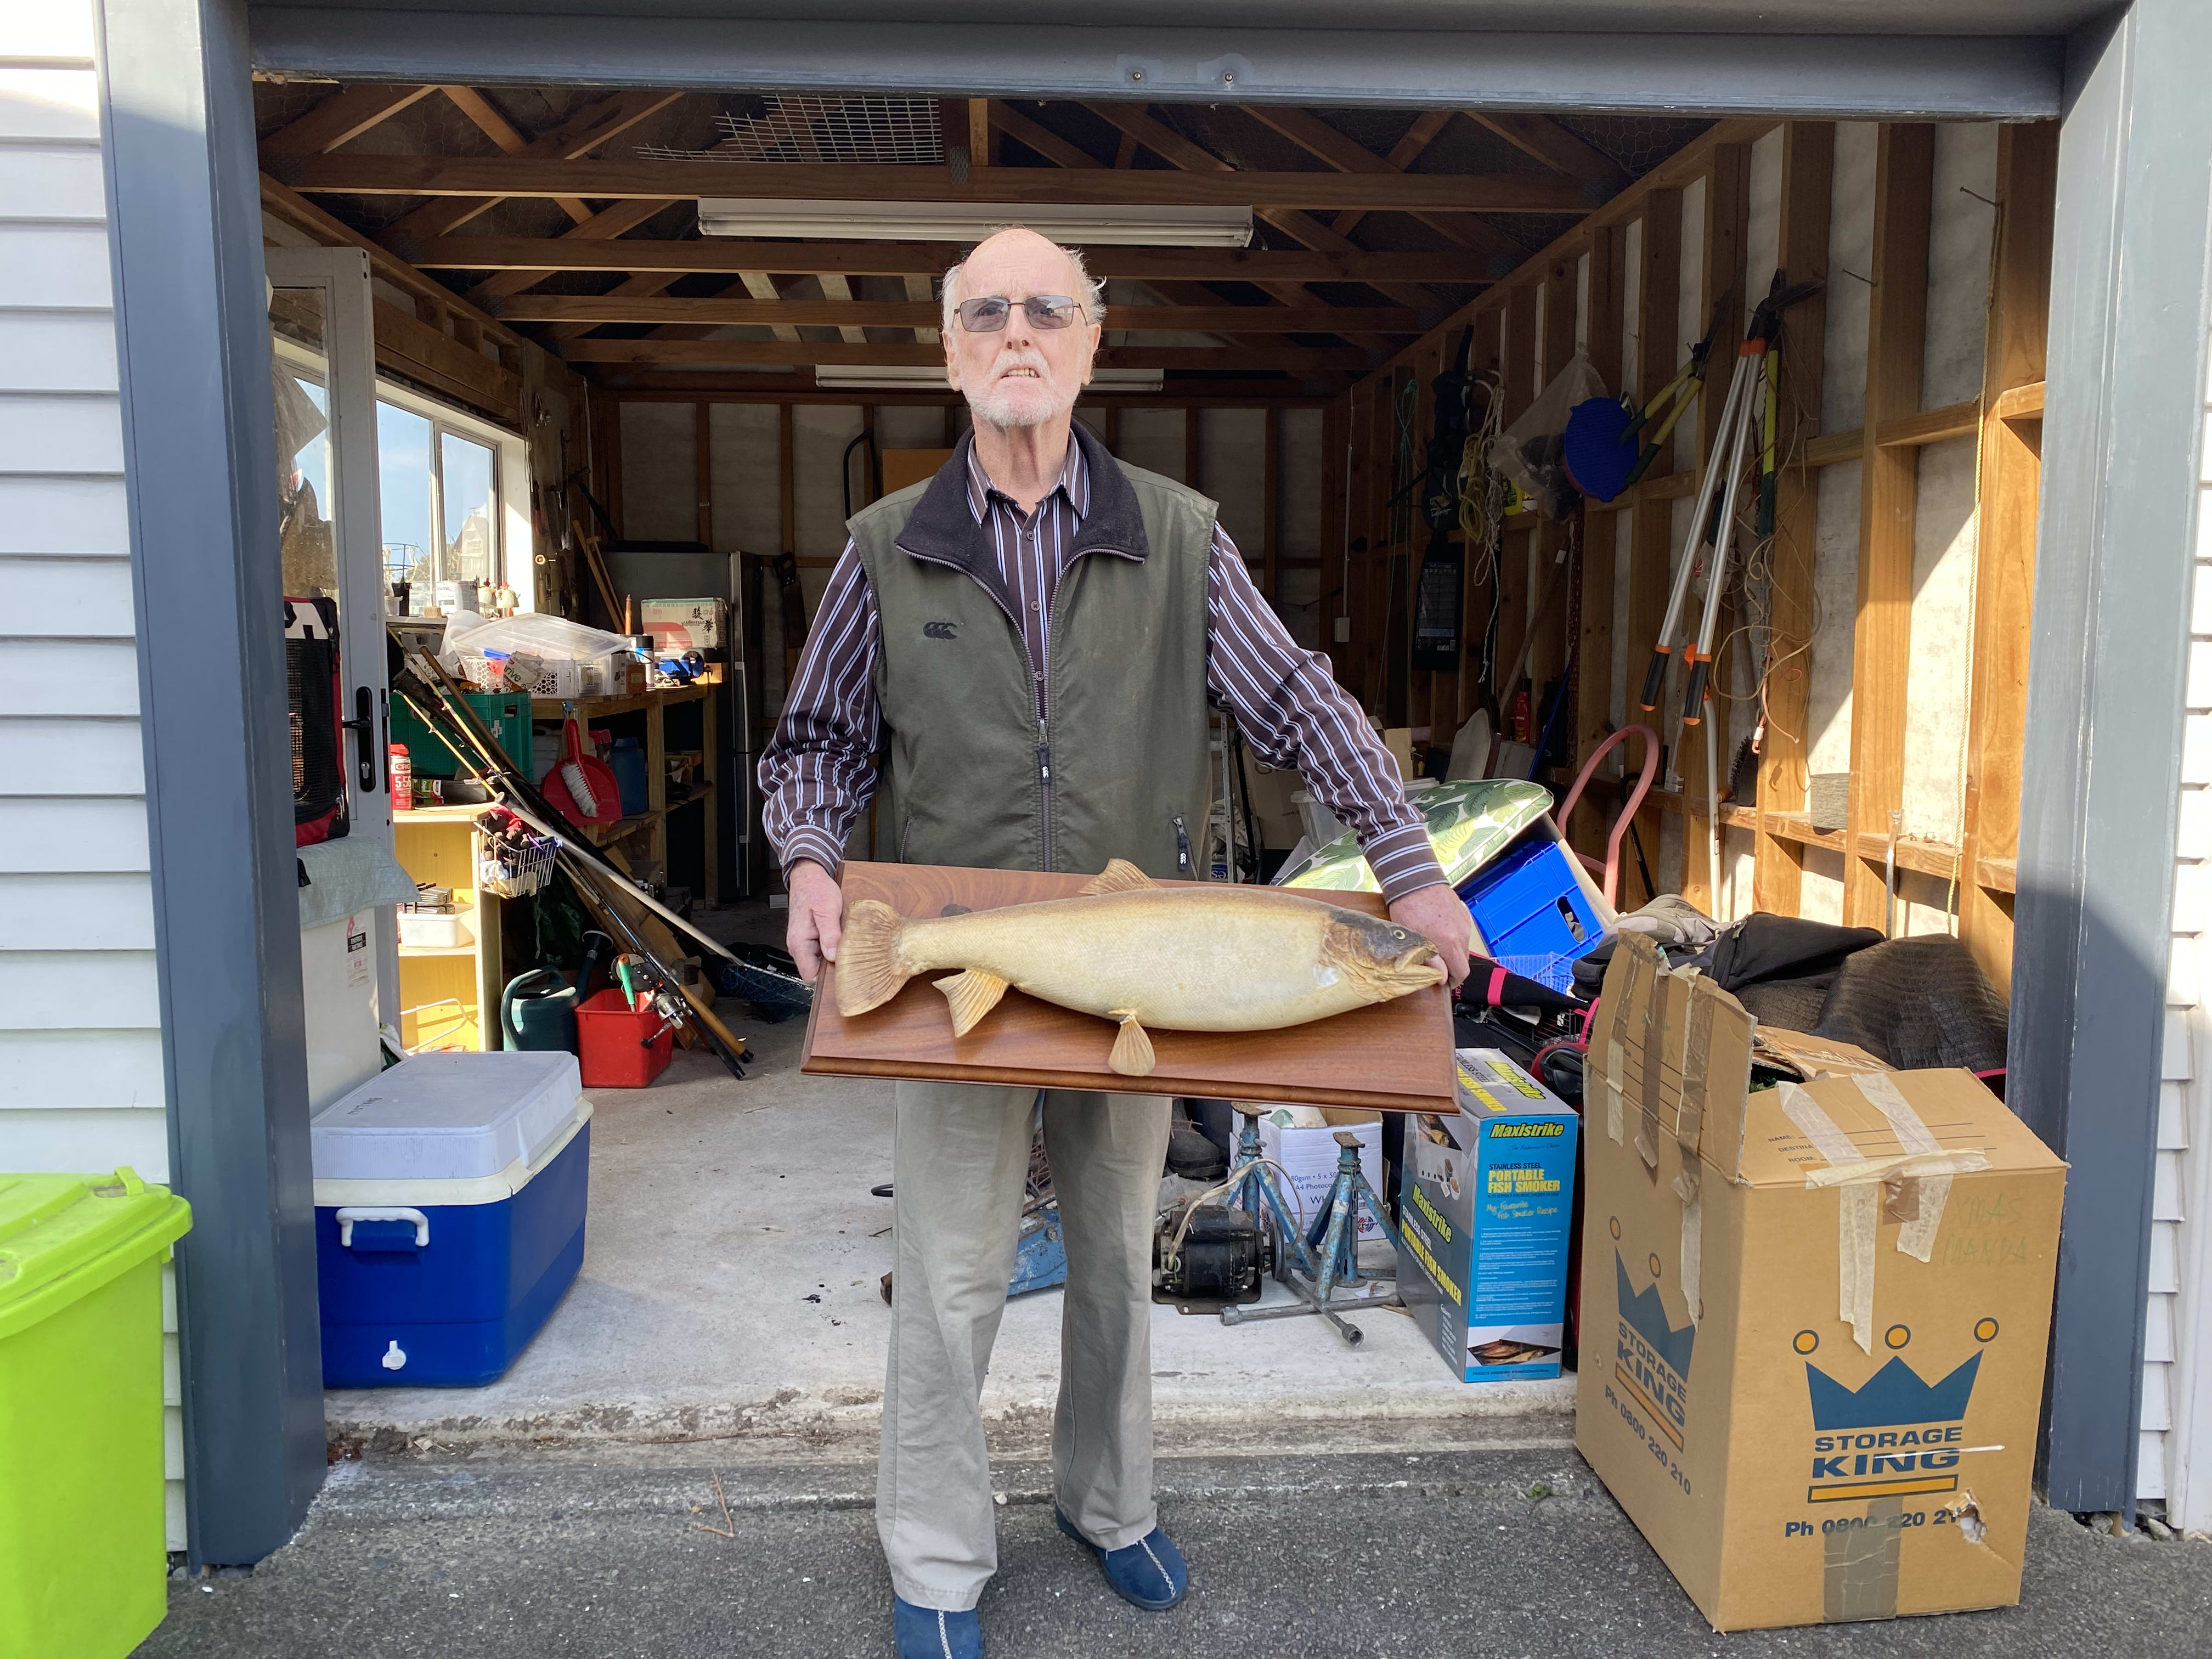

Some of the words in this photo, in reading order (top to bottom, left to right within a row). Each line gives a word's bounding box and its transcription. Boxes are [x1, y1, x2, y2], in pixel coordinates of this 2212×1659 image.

[1489, 1122, 1565, 1138] Maxistrike
[1778, 1144, 1816, 1153] DESTINA
[1488, 1169, 1544, 1182] PORTABLE
[1488, 1181, 1512, 1194] FISH
[1515, 1180, 1560, 1193] SMOKER
[1412, 1182, 1452, 1244] Maxistrike
[1537, 1206, 1558, 1216] Recipe
[1956, 1194, 2024, 1229] XMAS
[1402, 1205, 1421, 1235] STAINLESS
[1420, 1228, 1432, 1251] STEEL
[1402, 1218, 1425, 1261] PORTABLE
[1425, 1249, 1437, 1278] FISH
[1437, 1265, 1462, 1307] SMOKER
[1618, 1321, 1686, 1404] STORAGE
[1617, 1338, 1685, 1427] KING
[1605, 1384, 1617, 1409] Ph
[1621, 1403, 1645, 1440] 0800
[1648, 1435, 1667, 1468] 220
[1671, 1462, 1691, 1496] 210
[1815, 1426, 1963, 1452] STORAGE
[1812, 1447, 1960, 1479] KING
[1785, 1521, 1814, 1537] Ph
